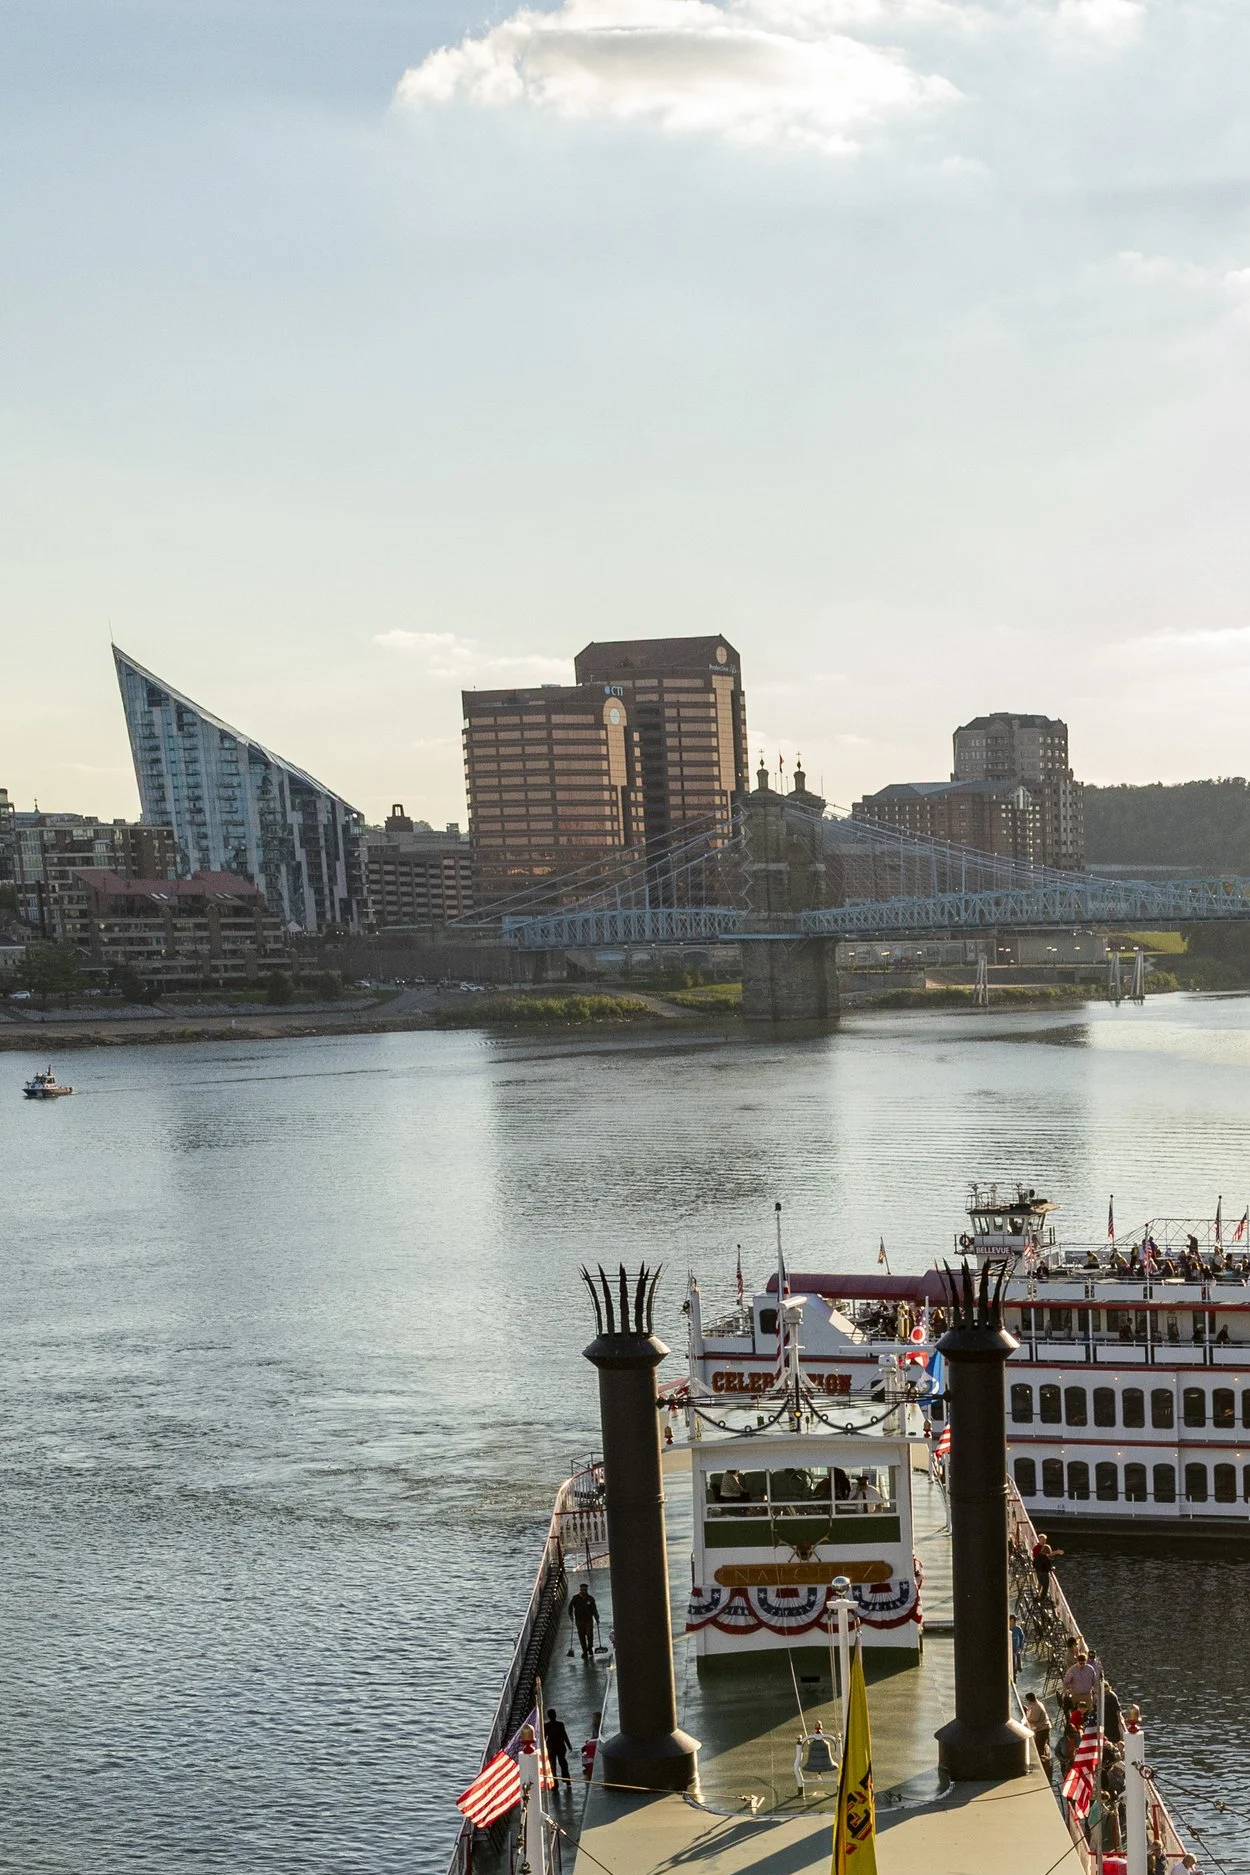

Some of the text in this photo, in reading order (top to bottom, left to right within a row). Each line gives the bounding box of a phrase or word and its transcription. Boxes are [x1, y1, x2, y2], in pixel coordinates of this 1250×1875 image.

[611, 686, 623, 696] CTI
[976, 1246, 1010, 1254] BELLEVUE
[712, 1371, 852, 1395] CELEBION
